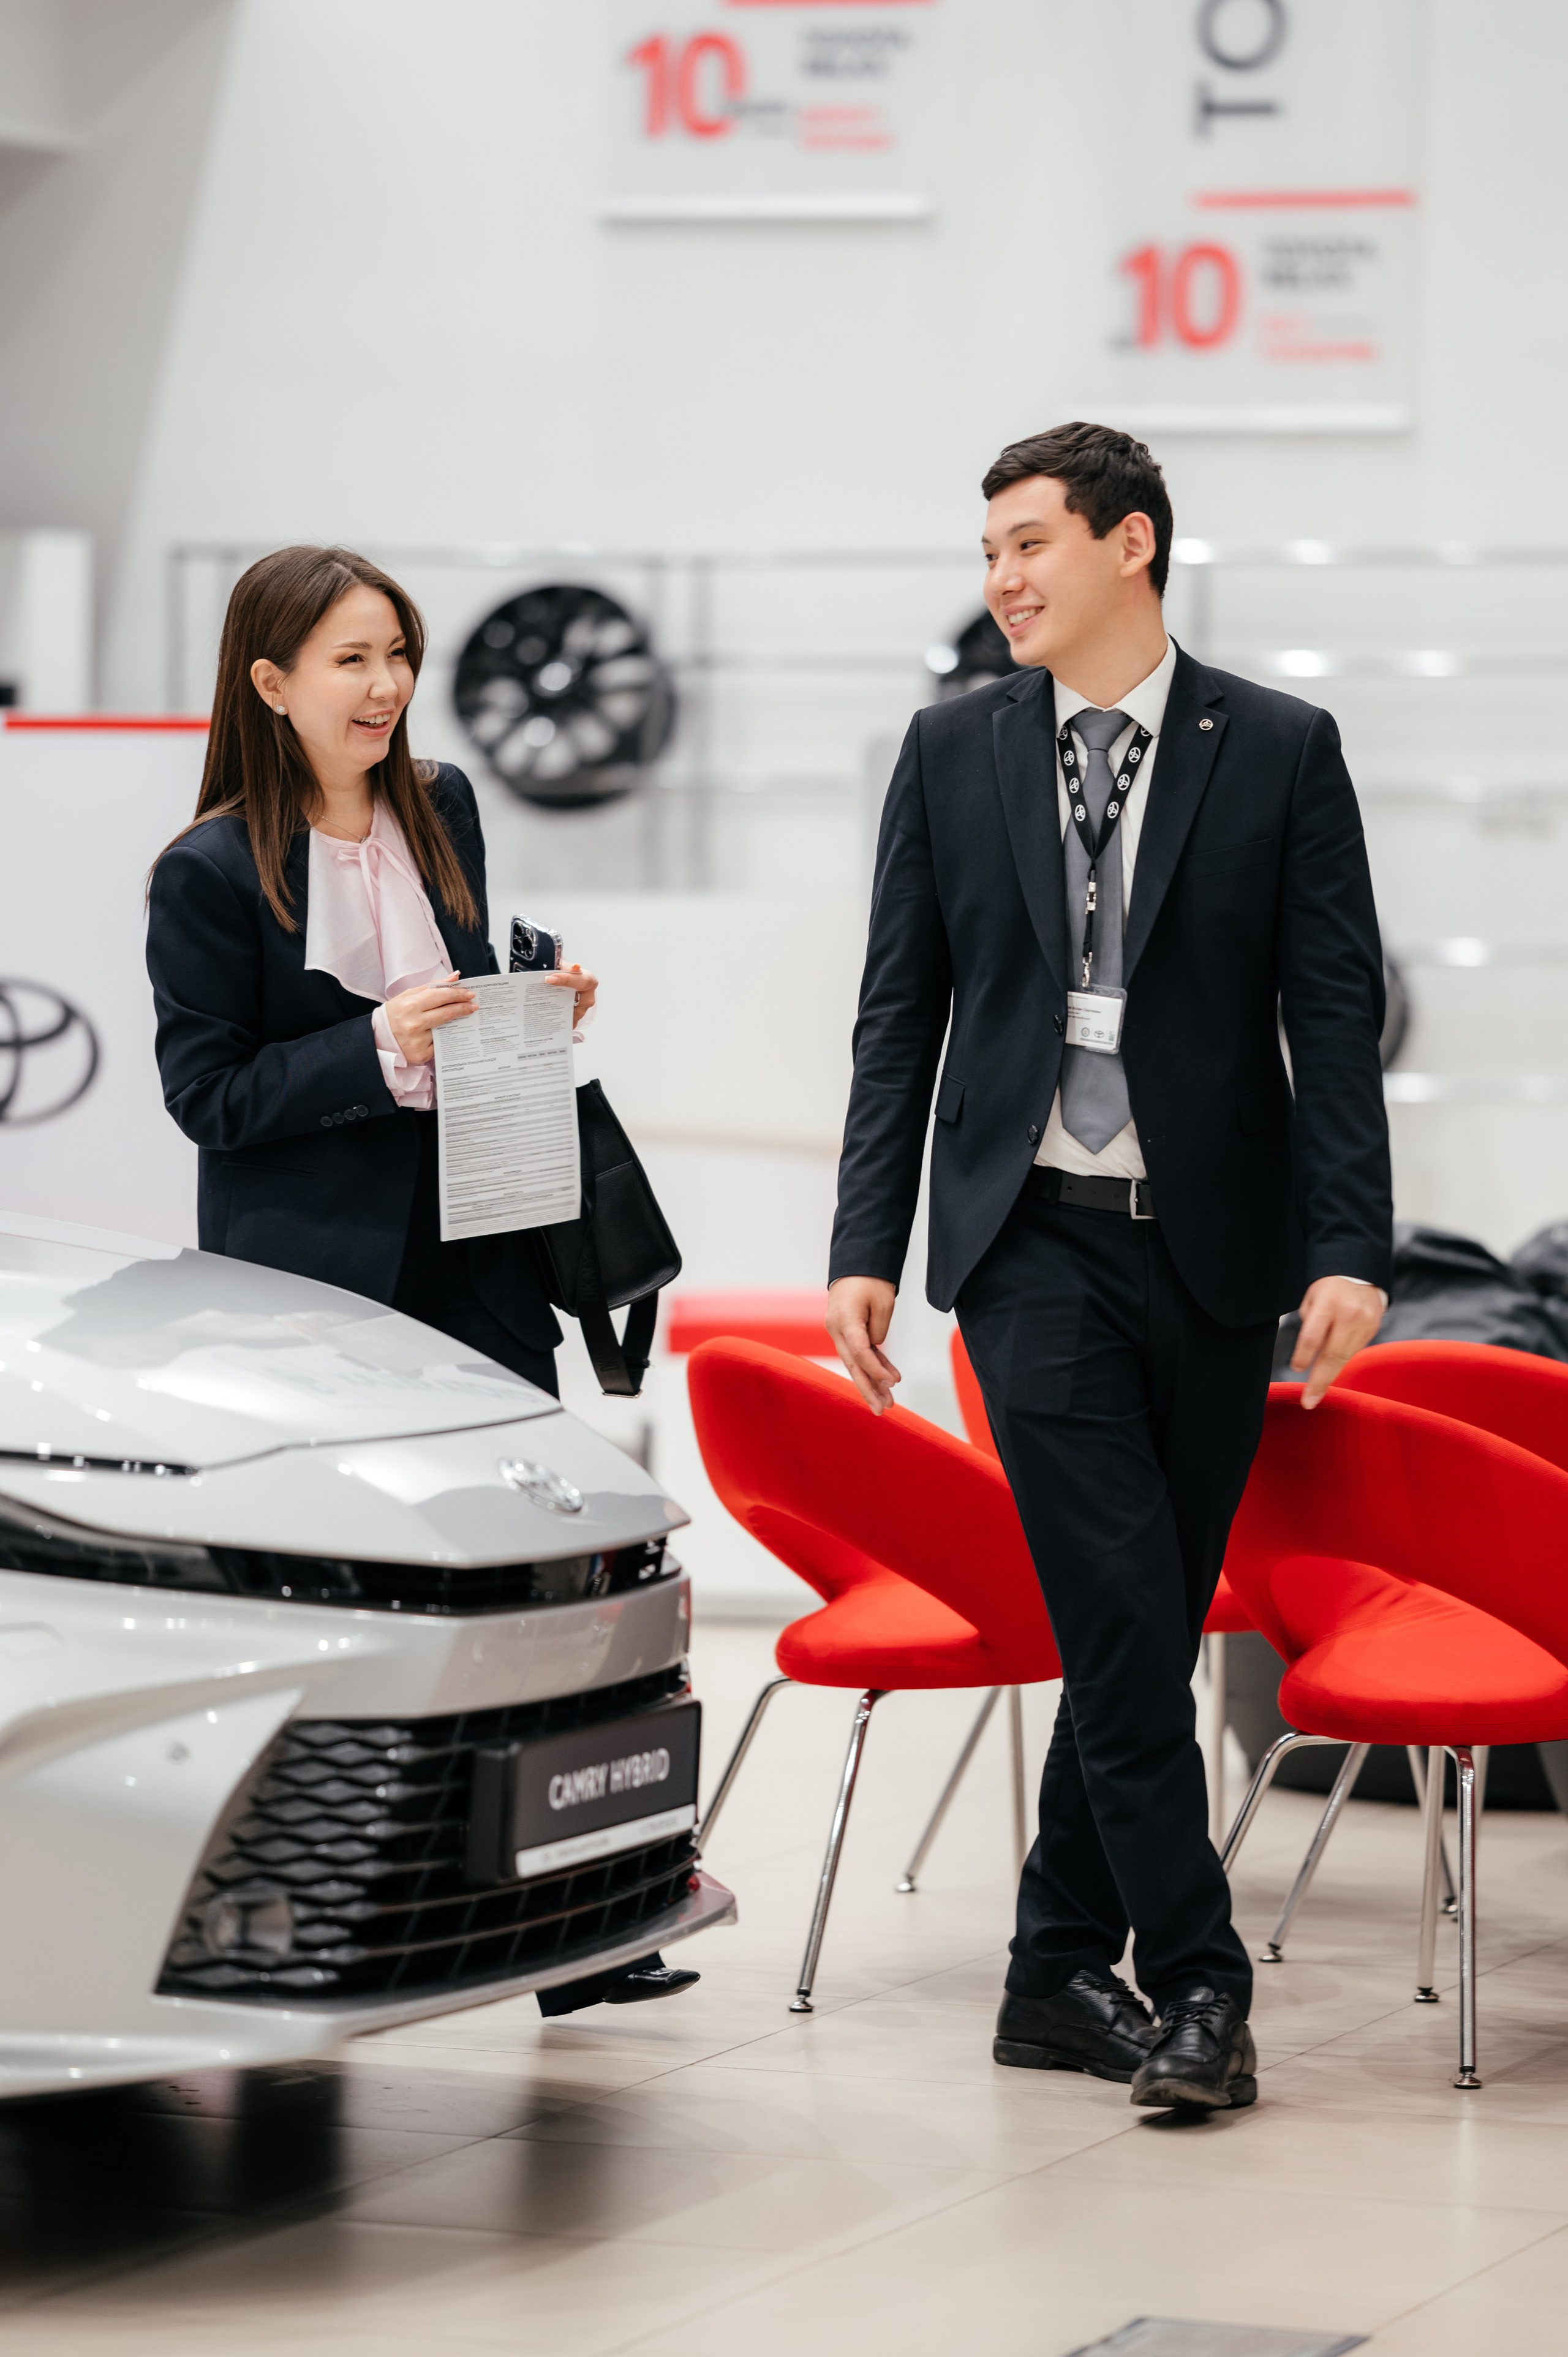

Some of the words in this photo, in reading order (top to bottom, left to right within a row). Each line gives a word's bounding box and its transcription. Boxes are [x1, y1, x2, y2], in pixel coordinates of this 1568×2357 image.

[627, 30, 747, 141] 10
[1192, 0, 1289, 138] TO
[1120, 241, 1244, 353] 10
[549, 1762, 609, 1811] CAMRY
[610, 1748, 670, 1795] HYBRID
